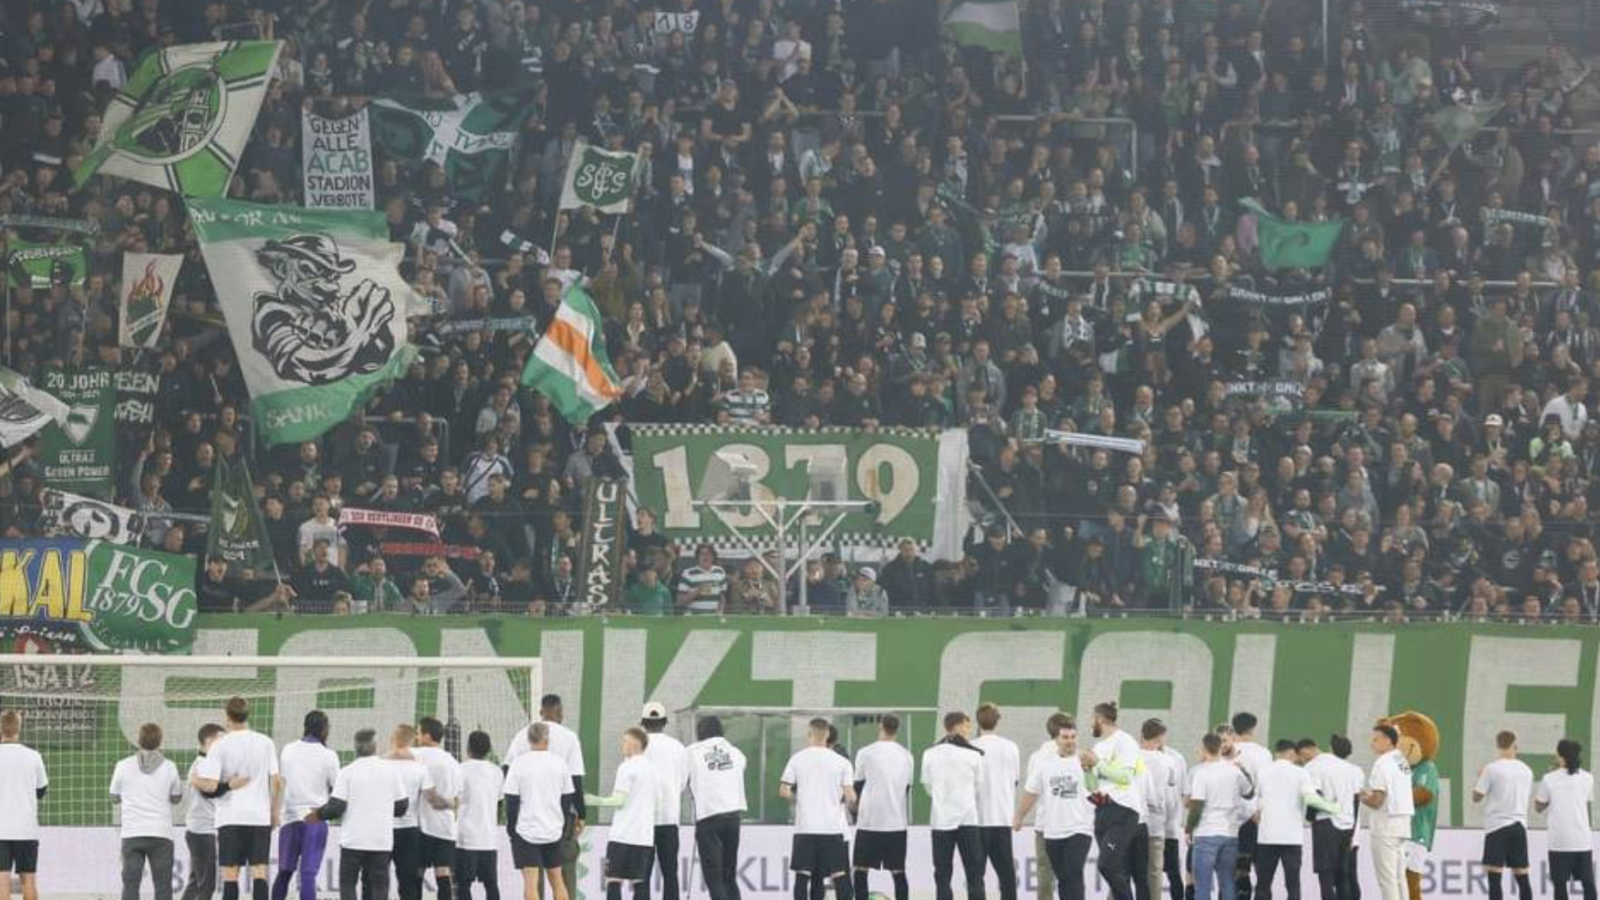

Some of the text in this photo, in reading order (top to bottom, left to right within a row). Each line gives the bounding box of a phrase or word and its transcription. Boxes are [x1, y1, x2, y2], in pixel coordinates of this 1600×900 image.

[310, 119, 358, 134] GEGEN
[313, 135, 358, 151] ALLE
[306, 152, 370, 173] ACAB
[307, 175, 370, 191] STADION
[47, 372, 65, 388] 20
[652, 443, 920, 529] 1879
[586, 481, 619, 606] ULTRAS
[89, 587, 140, 617] 1879
[117, 626, 1600, 827] SANKT GALLE
